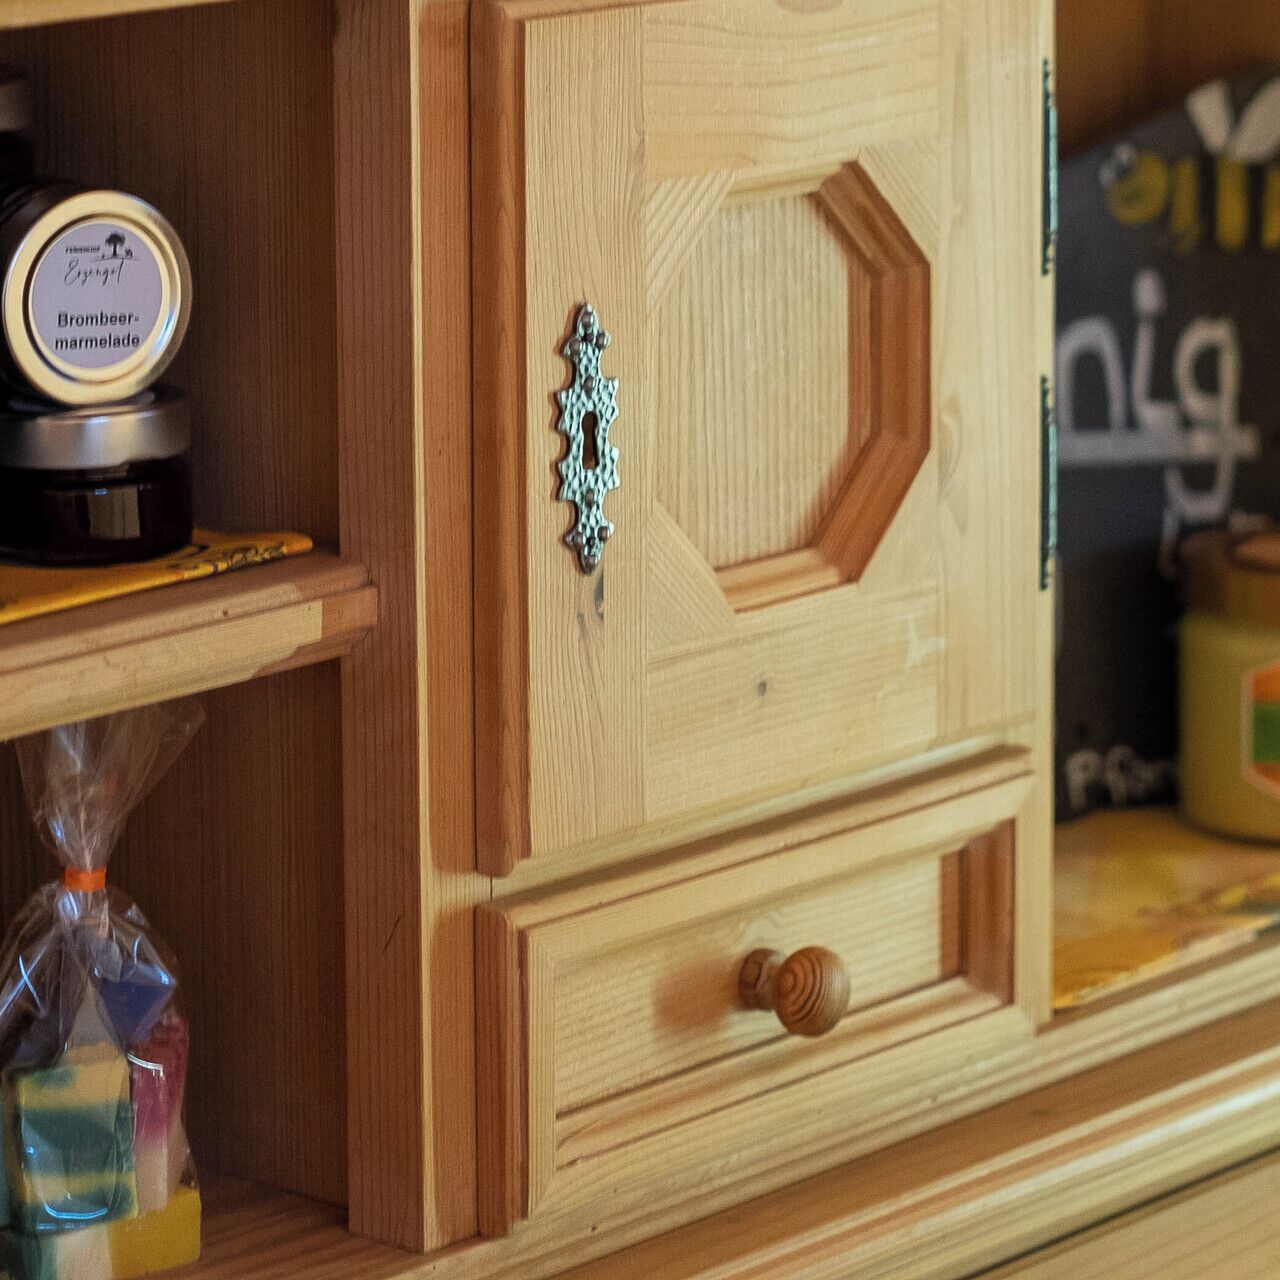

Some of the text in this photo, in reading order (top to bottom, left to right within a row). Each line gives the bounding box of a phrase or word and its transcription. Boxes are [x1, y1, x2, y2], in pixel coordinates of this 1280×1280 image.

[57, 311, 140, 328] Brombeer-
[55, 332, 140, 350] marmelade
[1056, 270, 1243, 524] nig
